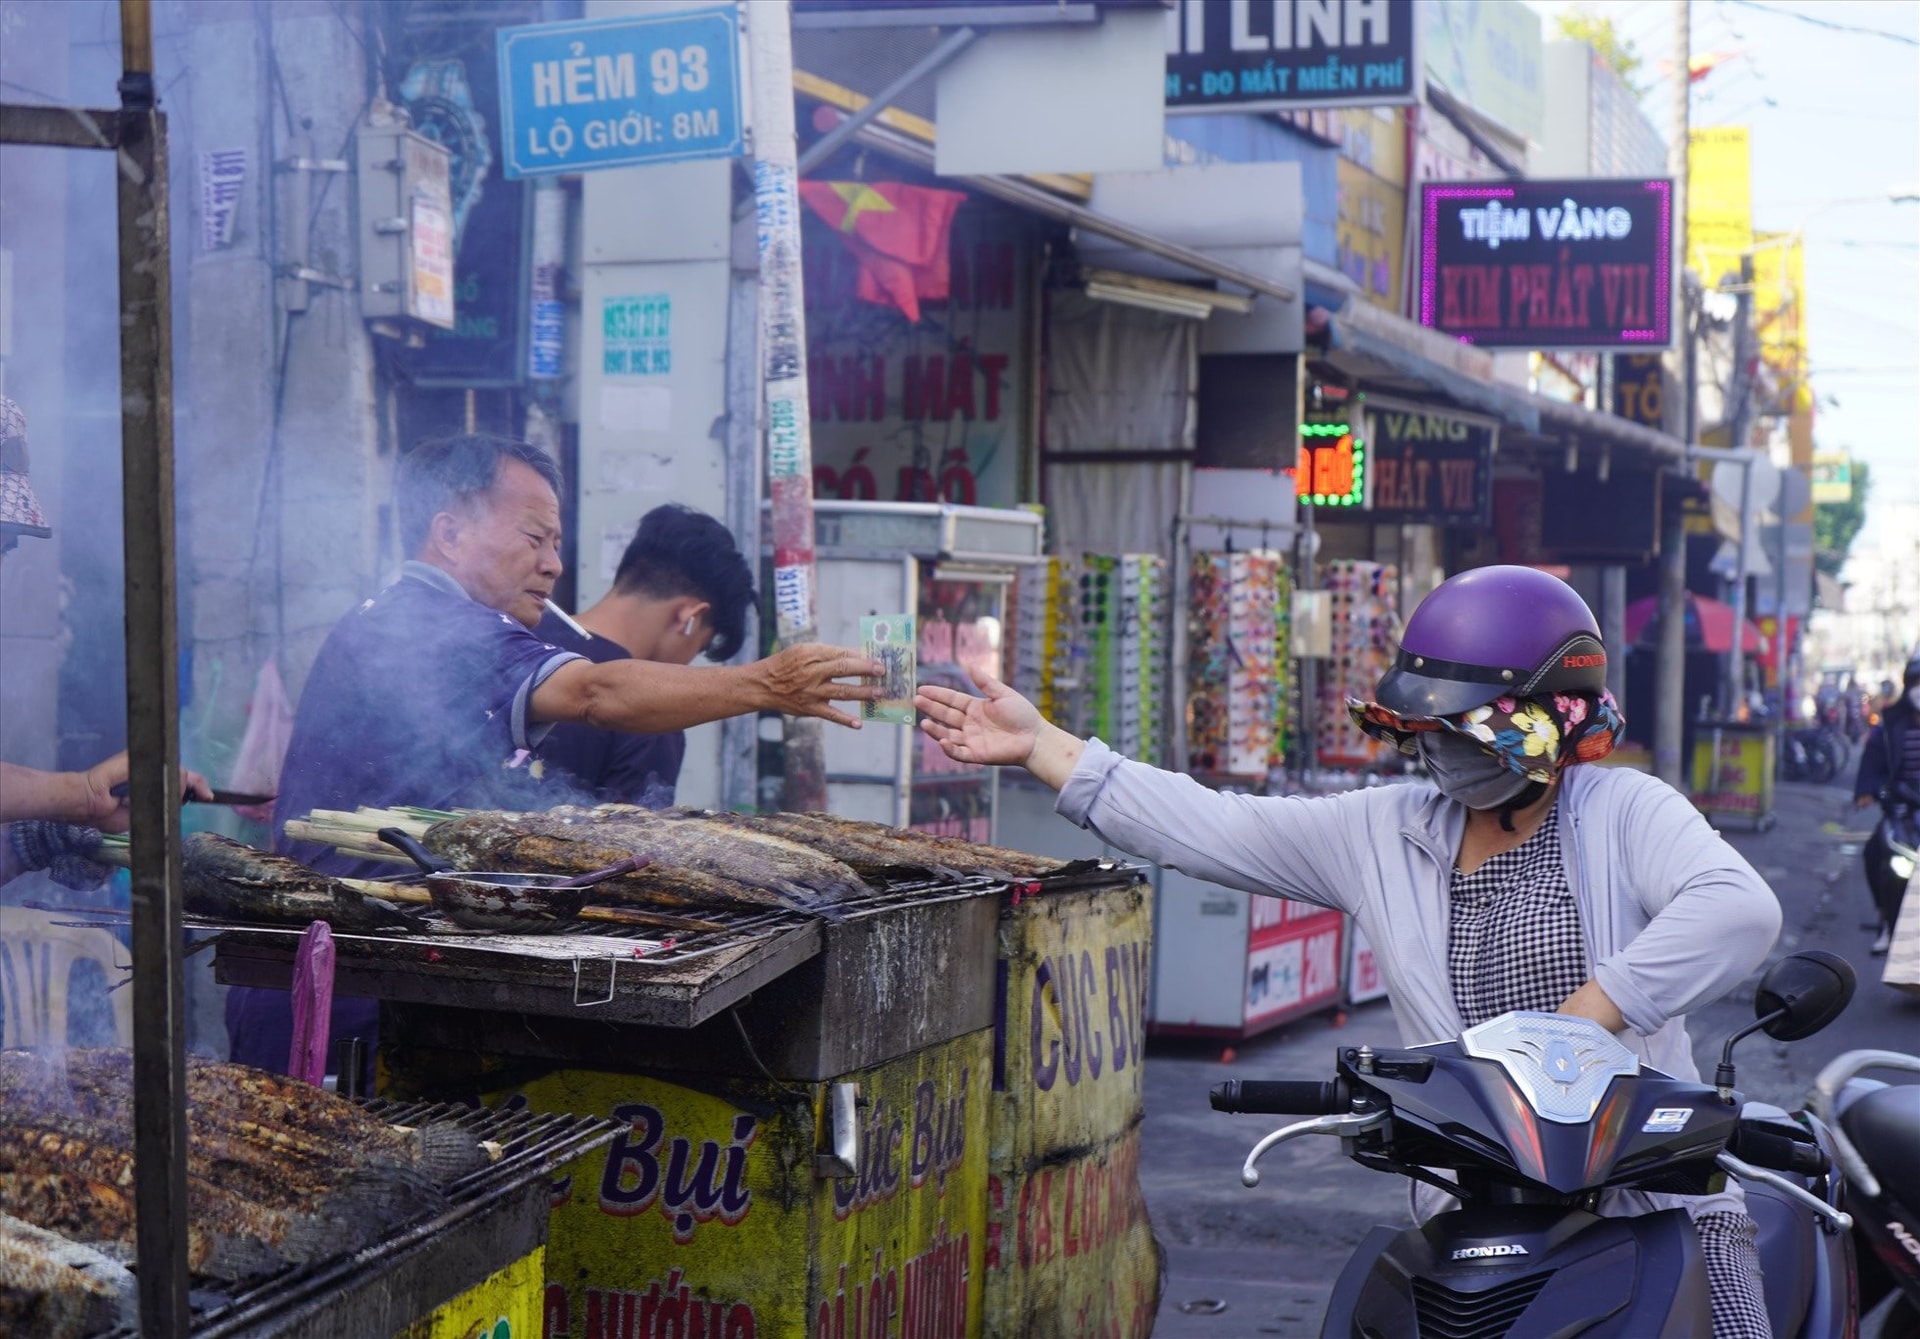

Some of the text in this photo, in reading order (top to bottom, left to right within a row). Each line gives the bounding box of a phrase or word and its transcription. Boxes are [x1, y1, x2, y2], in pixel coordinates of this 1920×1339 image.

[1230, 0, 1390, 50] LINH
[533, 41, 709, 107] HẺM 93
[528, 109, 719, 159] LỘ GIỚI: 8M
[1458, 197, 1633, 250] TIỆM VÀNG
[1441, 245, 1650, 328] KIM PHÁT VII
[910, 1067, 970, 1198] Bụi
[600, 1102, 758, 1243] Bụi
[1452, 1244, 1530, 1260] HONDA
